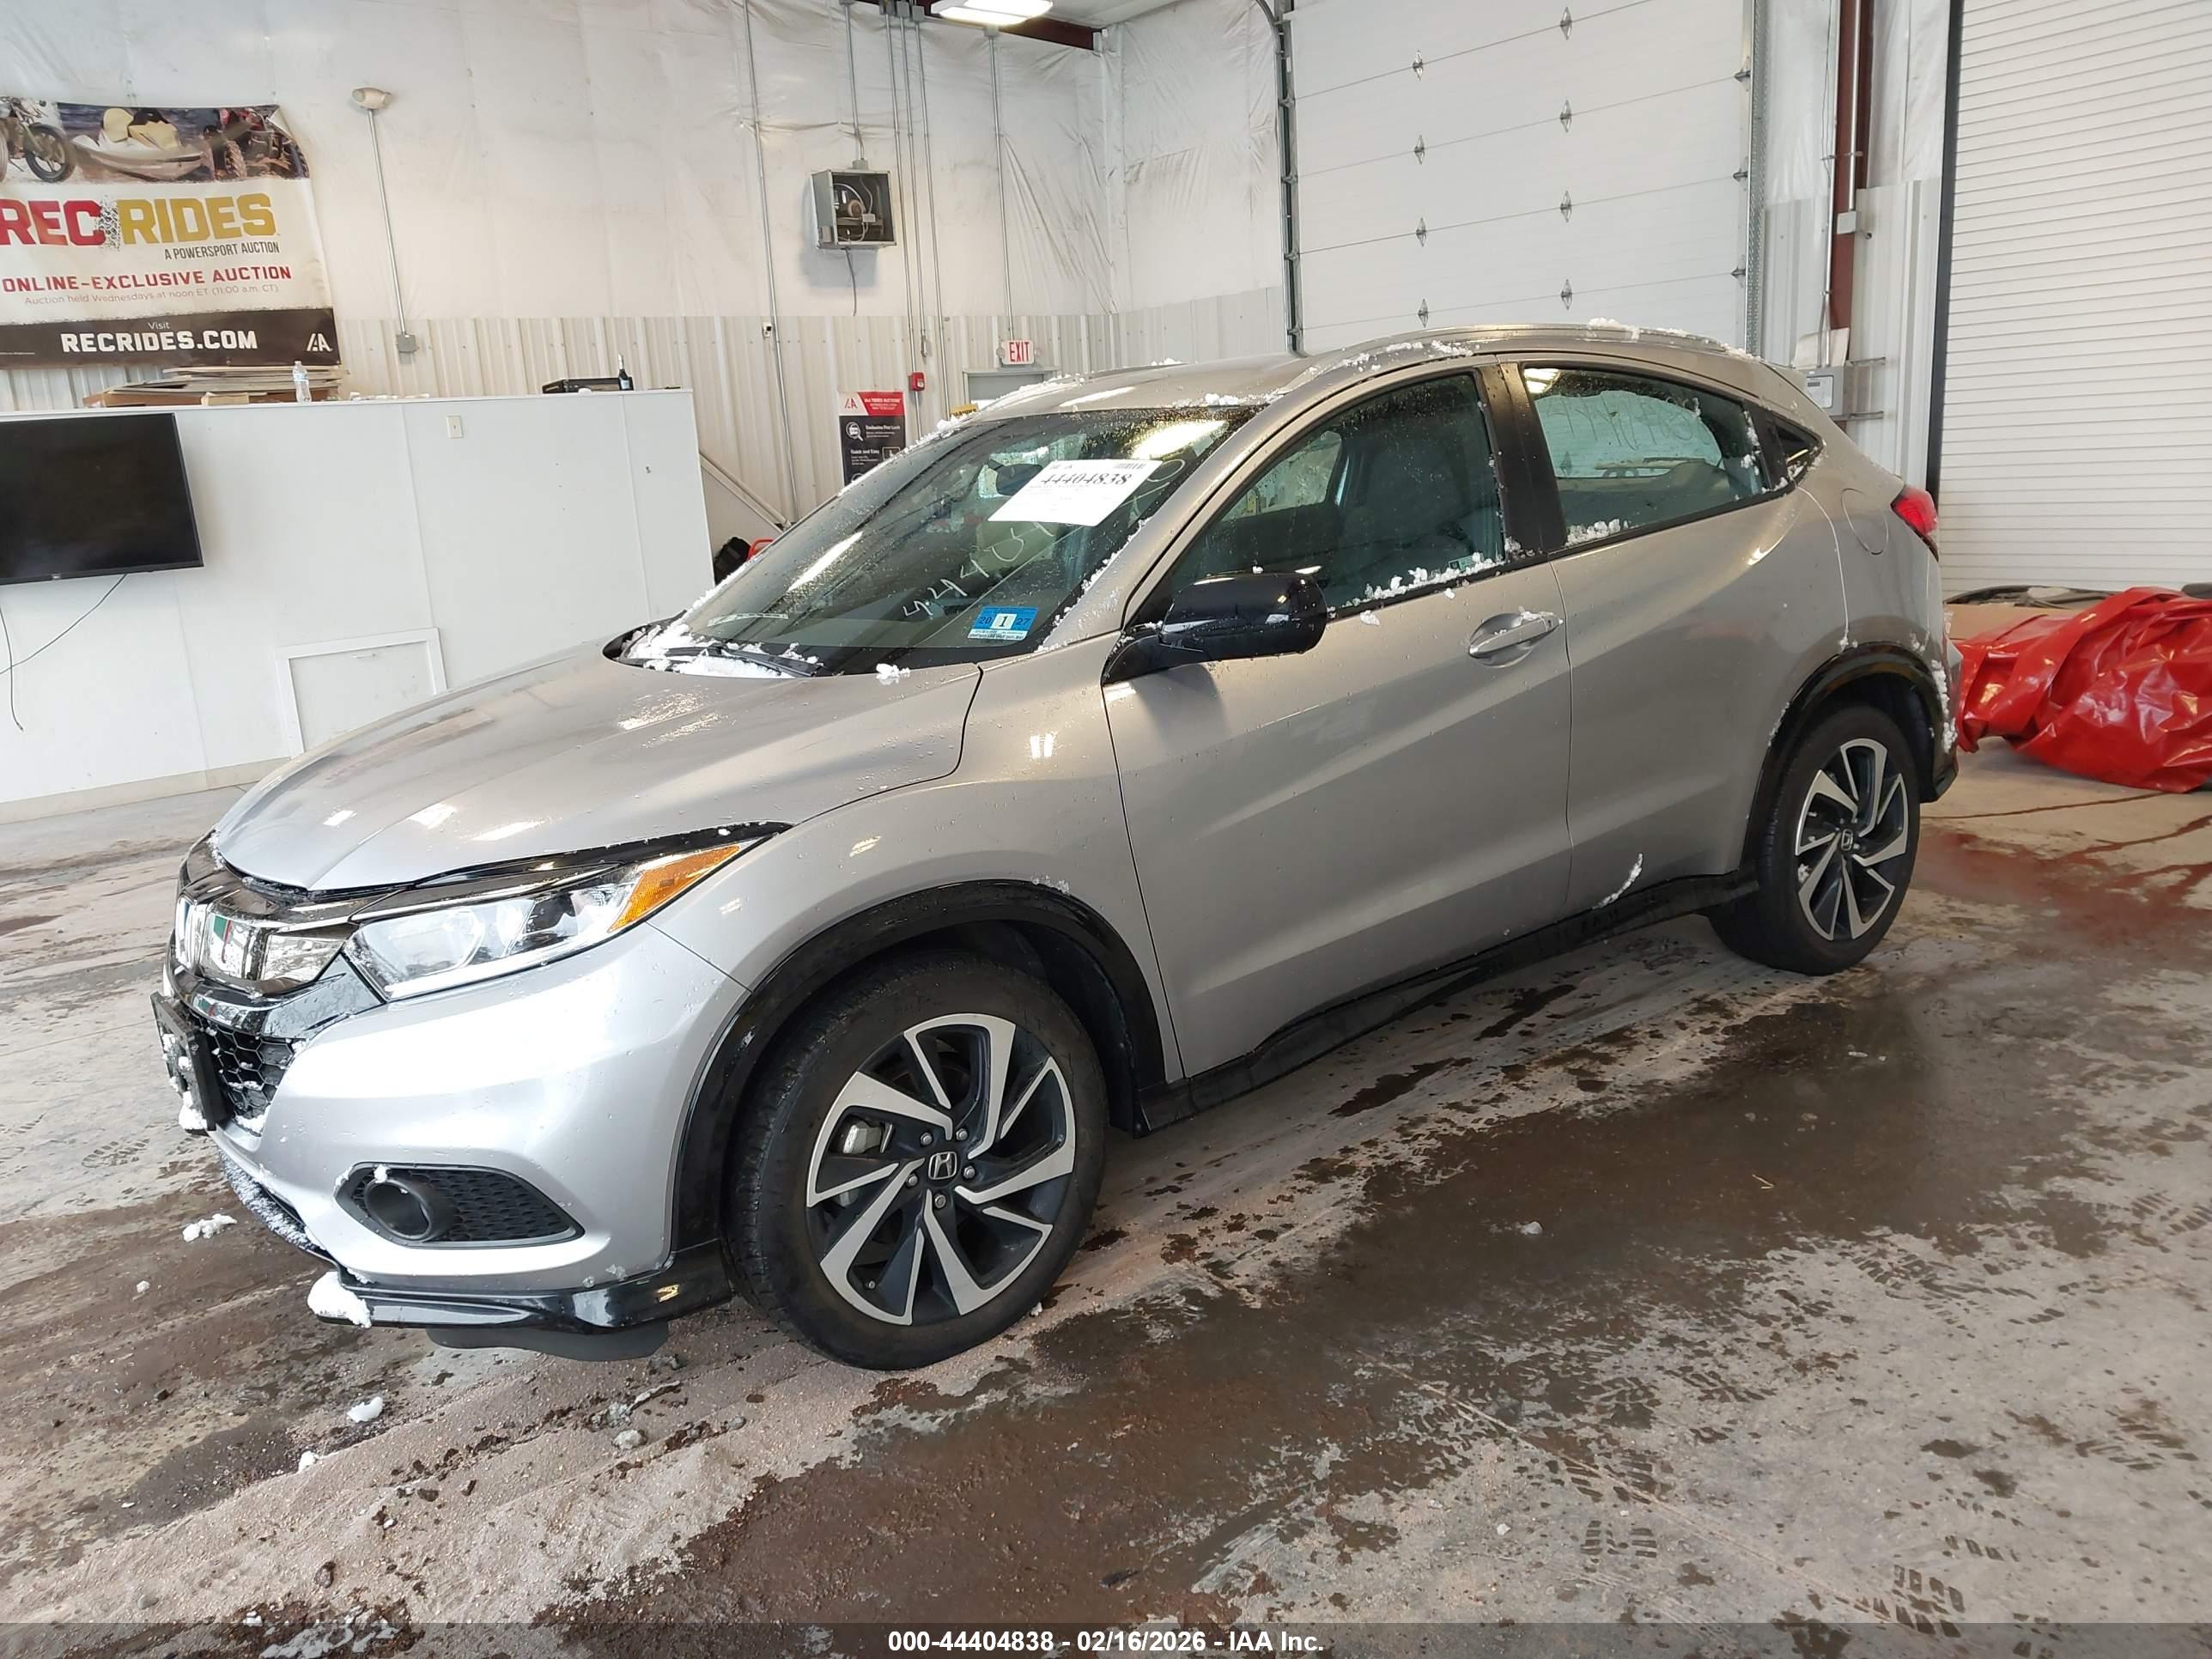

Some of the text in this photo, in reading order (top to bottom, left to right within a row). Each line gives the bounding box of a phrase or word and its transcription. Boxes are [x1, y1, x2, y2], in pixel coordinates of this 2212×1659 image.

[0, 193, 276, 246] REC RIDES
[164, 241, 280, 260] A POWERSPORT AUCTION
[2, 266, 292, 293] ONLINE-EXCLUSIVE AUCTION
[25, 295, 65, 305] Auction
[67, 294, 89, 303] held
[91, 291, 154, 302] Wednesdays
[196, 288, 209, 296] ET
[148, 321, 170, 330] Visit
[60, 330, 258, 353] RECRIDES.COM
[1009, 342, 1030, 362] EXIT
[1041, 473, 1133, 485] 44404838
[979, 616, 993, 625] 20
[999, 615, 1008, 627] 1
